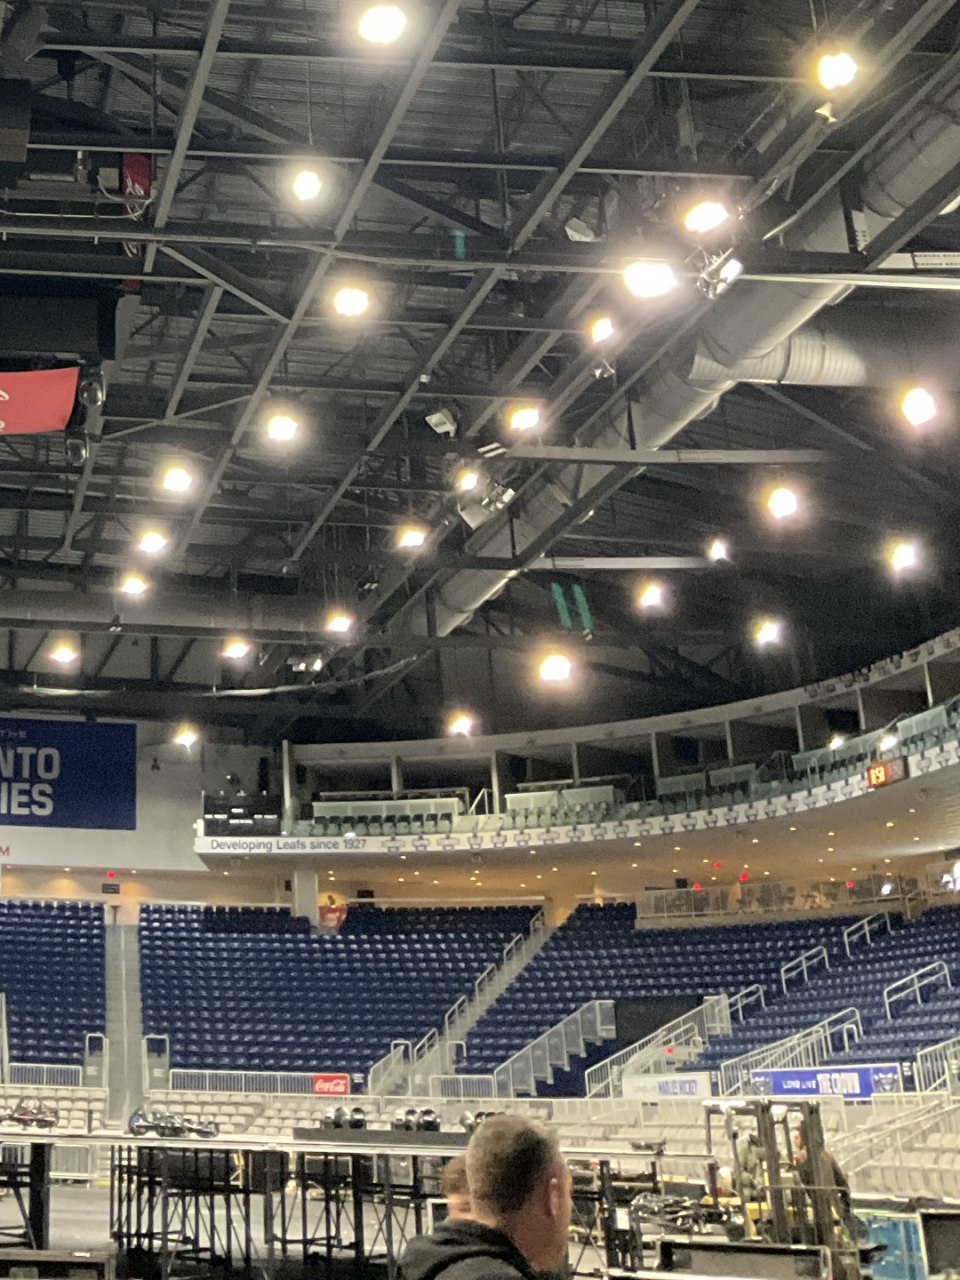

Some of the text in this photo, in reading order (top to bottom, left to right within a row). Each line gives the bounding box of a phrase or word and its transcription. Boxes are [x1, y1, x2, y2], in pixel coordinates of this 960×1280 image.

[0, 730, 27, 739] THE
[211, 839, 367, 852] Developing Leafs since 1927
